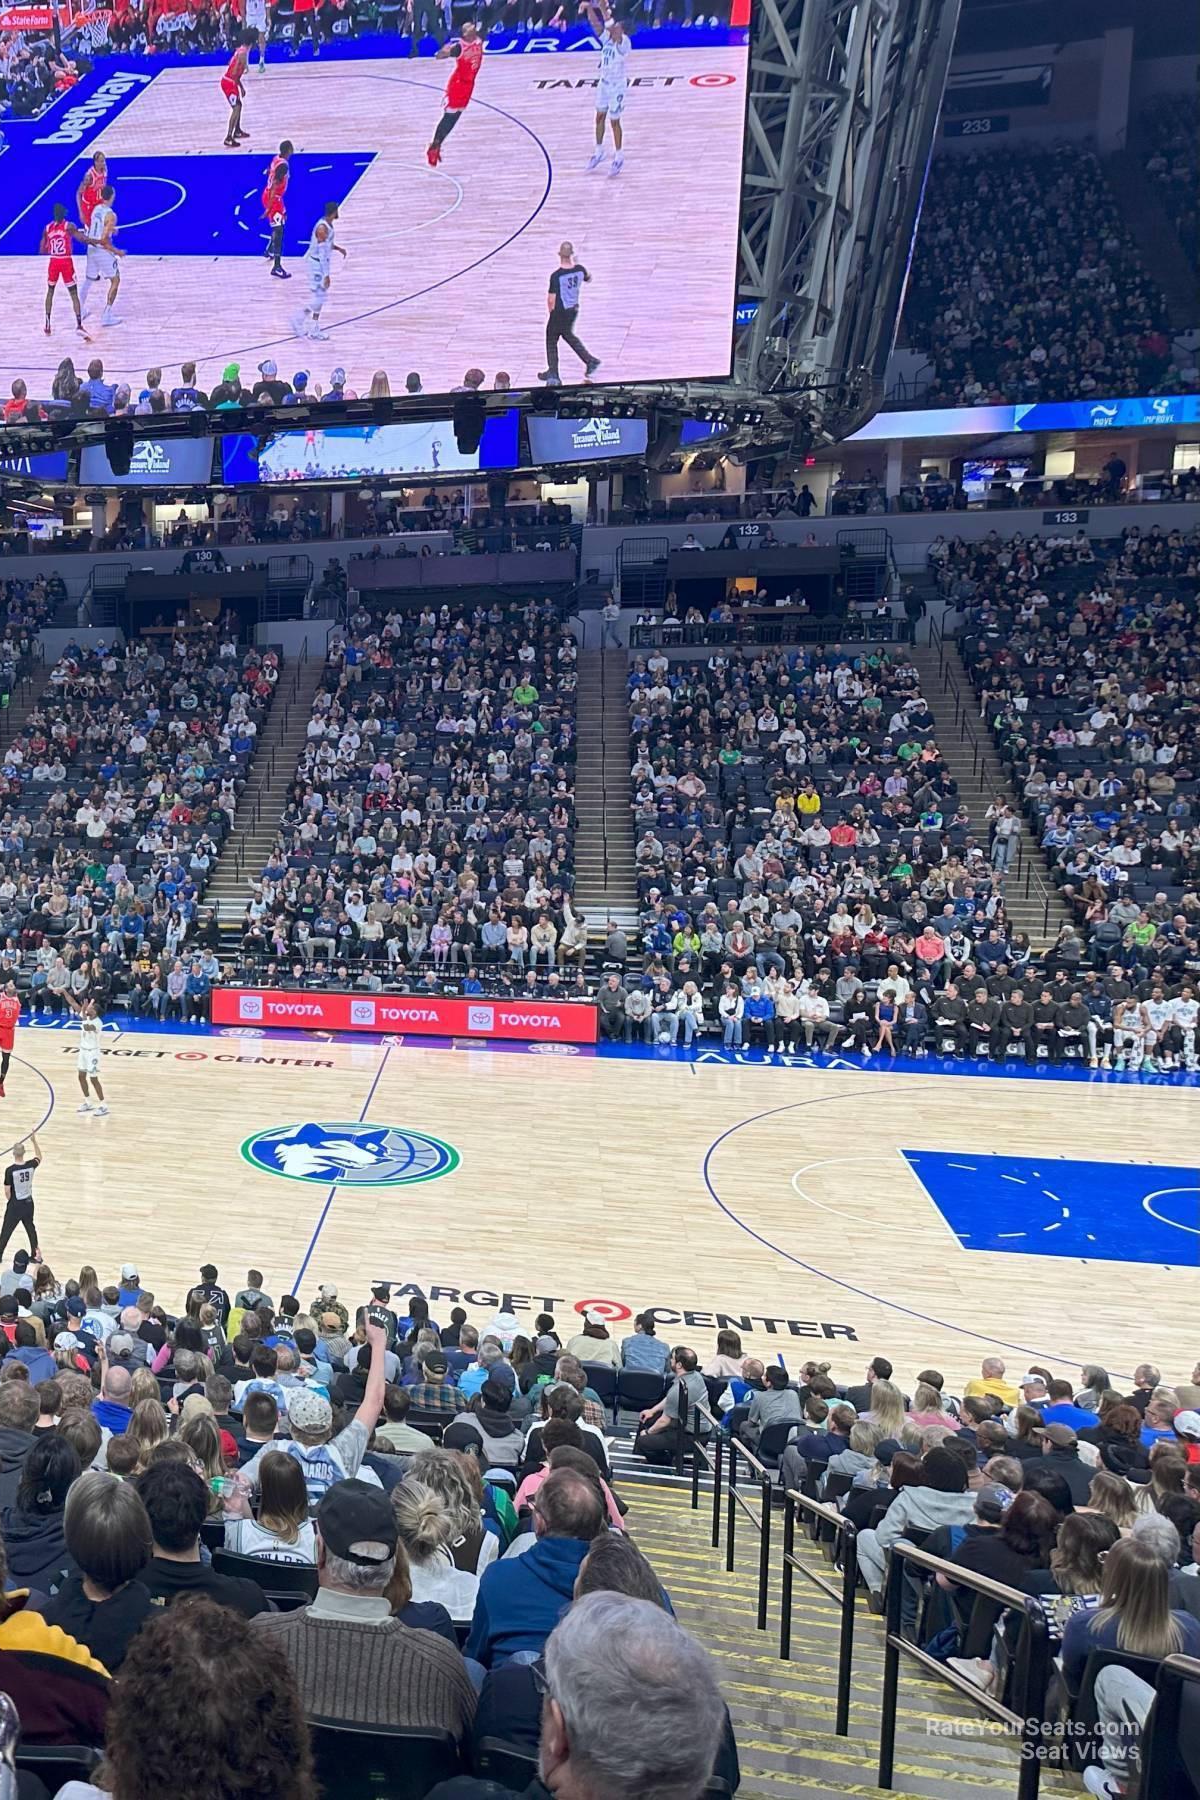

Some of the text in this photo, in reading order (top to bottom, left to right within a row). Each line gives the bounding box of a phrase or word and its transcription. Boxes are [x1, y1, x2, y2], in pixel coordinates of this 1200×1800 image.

[484, 36, 601, 53] URA
[533, 76, 684, 89] TARET
[32, 71, 152, 144] betway
[962, 119, 991, 134] 233
[50, 238, 65, 254] 12
[567, 276, 578, 289] 39
[1093, 417, 1114, 426] MOVE
[1143, 415, 1175, 424] IMPROVE
[572, 428, 620, 443] Treasure Island
[1055, 512, 1077, 523] 133
[739, 525, 759, 536] 132
[195, 551, 212, 561] 130
[267, 1003, 324, 1017] TOYOTA
[380, 1008, 439, 1022] TOYOTA
[29, 1018, 120, 1031] URA
[500, 1013, 561, 1028] TOYOTA
[944, 1039, 955, 1051] G
[1007, 1042, 1017, 1054] G
[1037, 1045, 1048, 1057] G
[1065, 1044, 1076, 1056] G
[60, 1046, 334, 1068] TRGET CENTER
[20, 1171, 30, 1183] 39
[371, 1280, 859, 1341] TARGET CENTER
[302, 1461, 333, 1480] WARDS
